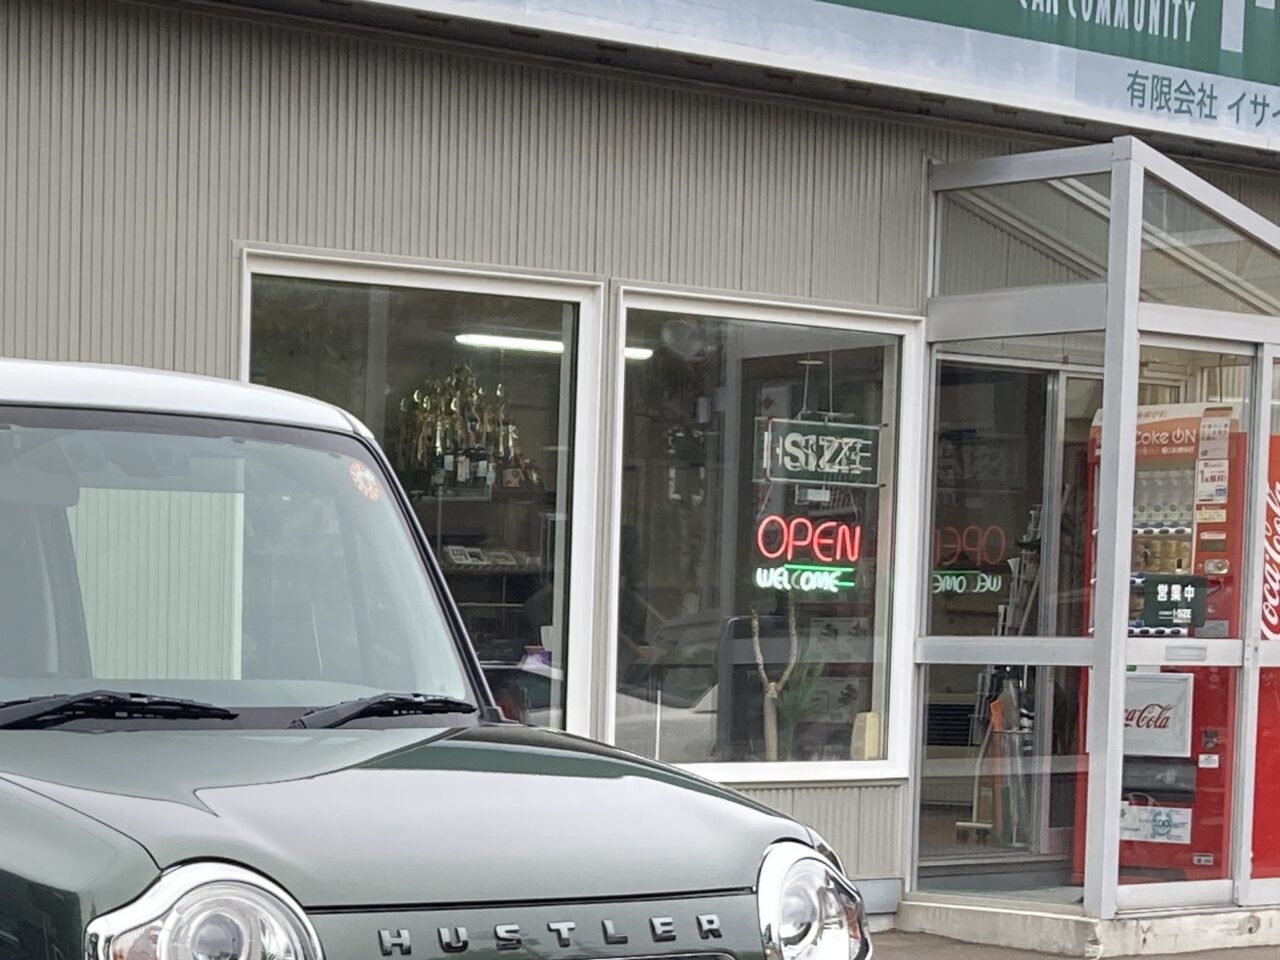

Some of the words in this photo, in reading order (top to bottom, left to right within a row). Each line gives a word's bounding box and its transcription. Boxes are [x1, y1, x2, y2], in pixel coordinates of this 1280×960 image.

[1127, 70, 1218, 120] 有限会社
[757, 514, 862, 562] OPEN
[756, 566, 842, 592] WELCOME
[1157, 583, 1195, 602] 営業中
[378, 914, 722, 956] HUSTLER
